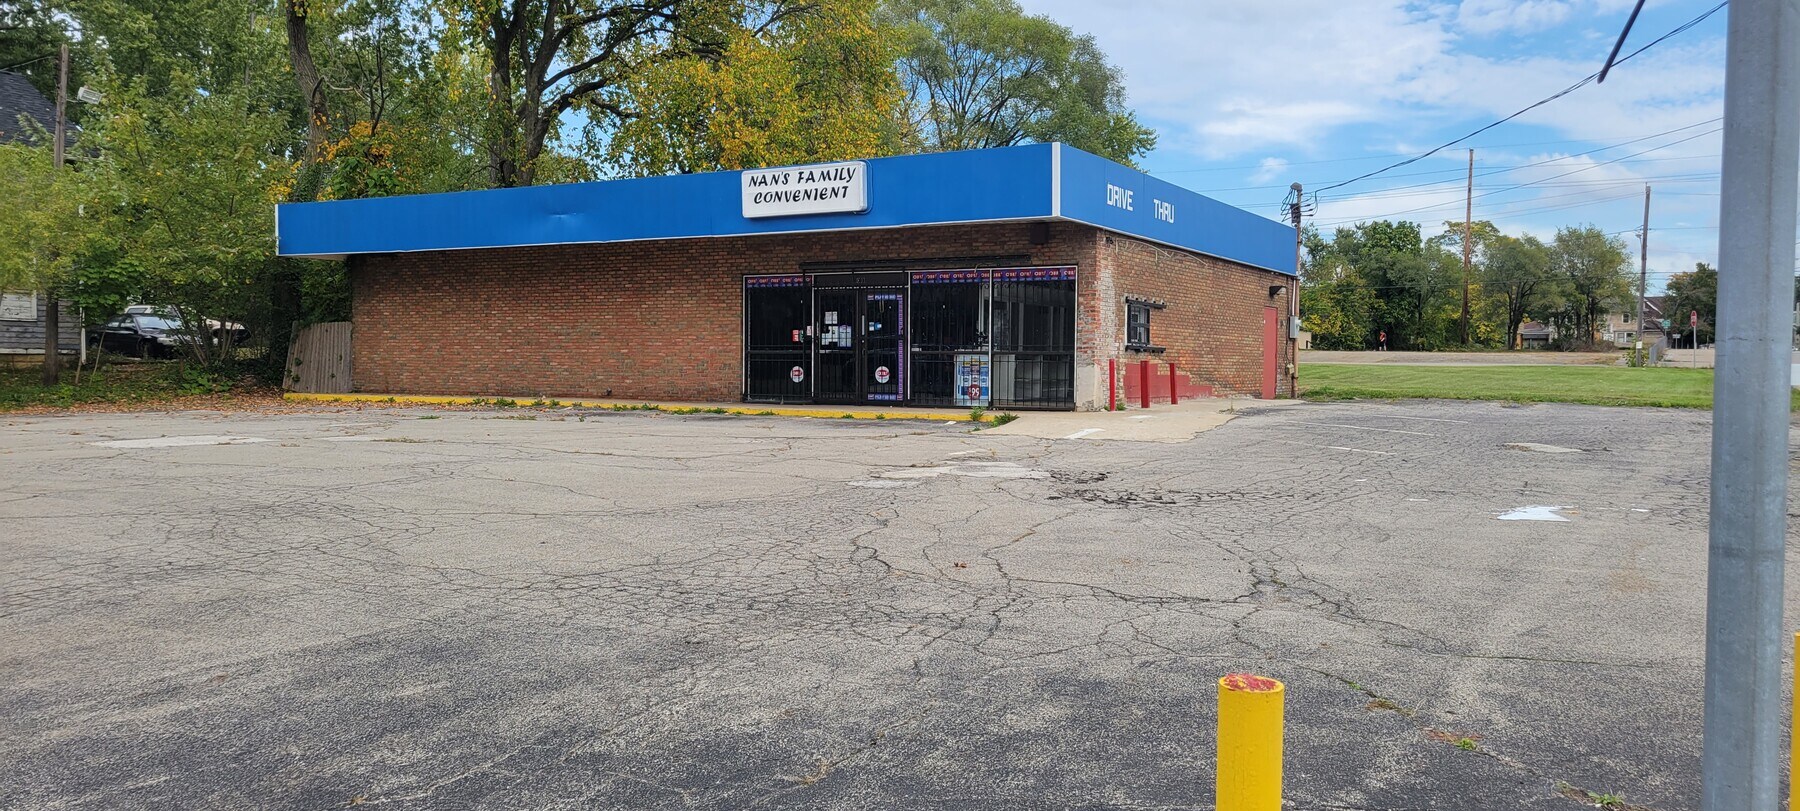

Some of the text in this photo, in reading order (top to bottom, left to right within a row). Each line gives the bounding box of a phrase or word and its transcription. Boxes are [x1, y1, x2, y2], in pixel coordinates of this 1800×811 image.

[748, 167, 857, 187] NAN'S FAMILY
[753, 186, 849, 205] CONVENIENT
[1106, 183, 1175, 224] DRIVE THRU
